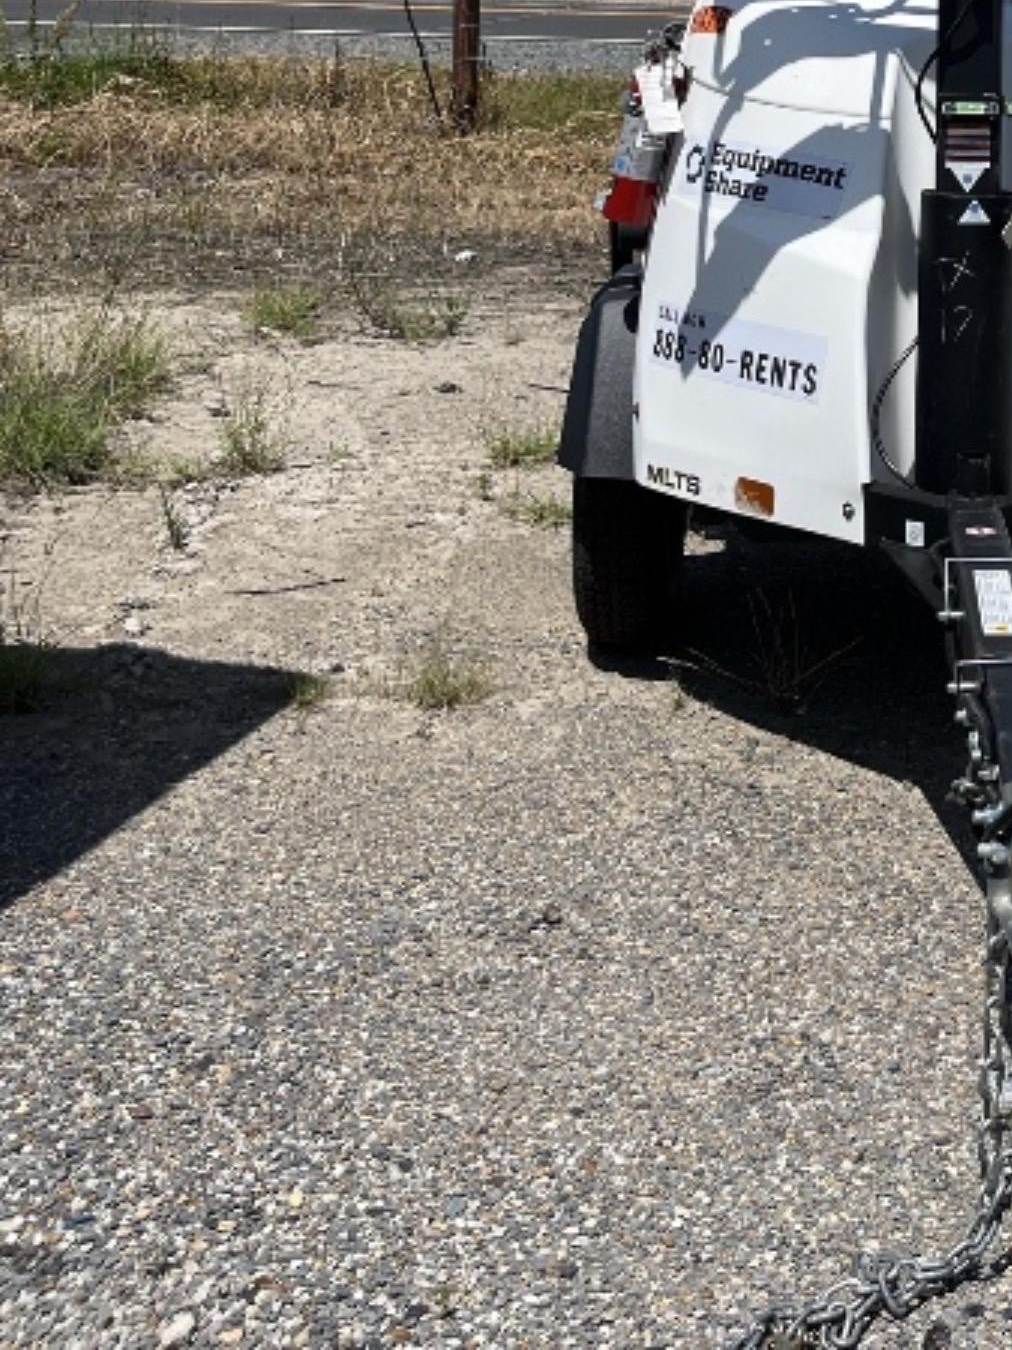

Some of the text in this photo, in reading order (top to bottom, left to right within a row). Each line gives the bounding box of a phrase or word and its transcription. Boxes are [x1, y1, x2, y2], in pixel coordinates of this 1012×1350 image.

[704, 170, 769, 202] Share
[709, 143, 847, 190] Equipment
[653, 328, 818, 396] 888-80-RENTS
